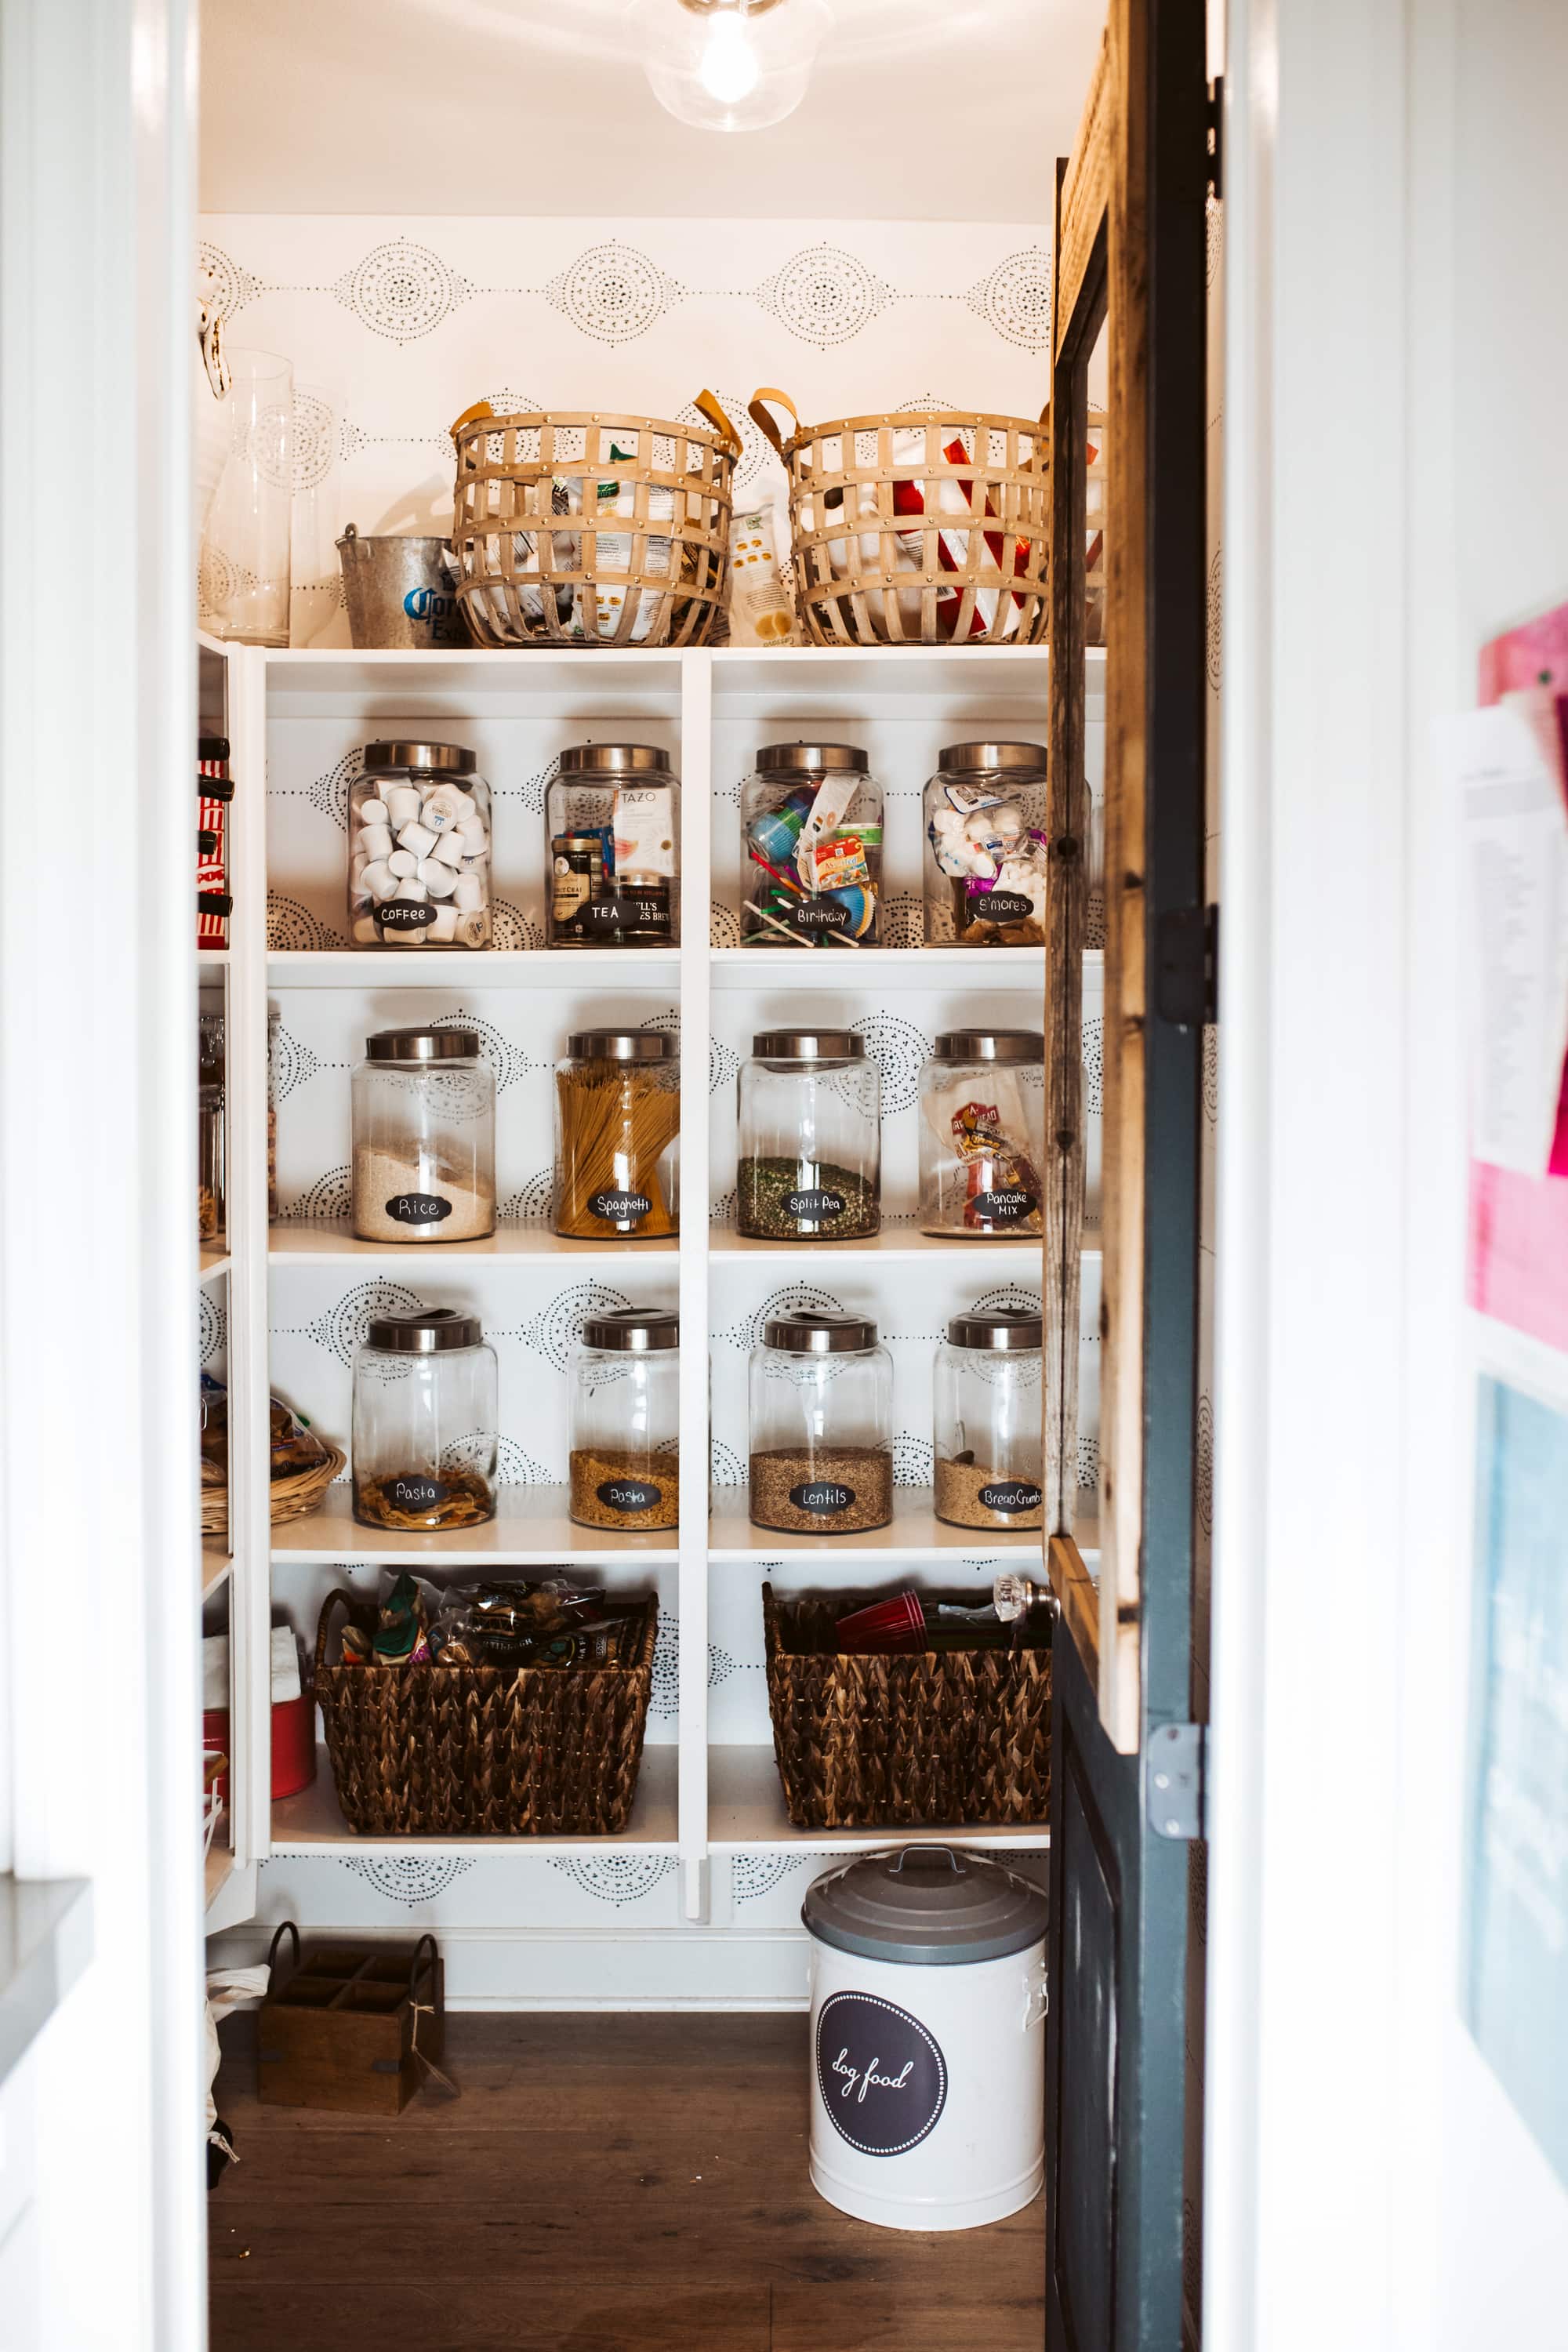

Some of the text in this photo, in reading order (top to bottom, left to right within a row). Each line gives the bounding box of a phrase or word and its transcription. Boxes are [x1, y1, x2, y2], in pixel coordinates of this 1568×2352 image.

[404, 587, 456, 625] Cor
[621, 792, 656, 804] TAZO
[979, 897, 1027, 911] S'mores
[591, 906, 619, 919] TEA
[797, 909, 846, 926] Birthday
[790, 1196, 840, 1214] Split Pea
[986, 1192, 1027, 1204] Pancake
[399, 1199, 439, 1215] Rice
[597, 1196, 648, 1218] Spaghetti
[396, 1483, 436, 1501] Pasta
[610, 1488, 646, 1504] Pasta
[803, 1489, 847, 1504] Lentils
[832, 2048, 914, 2103] dog food
